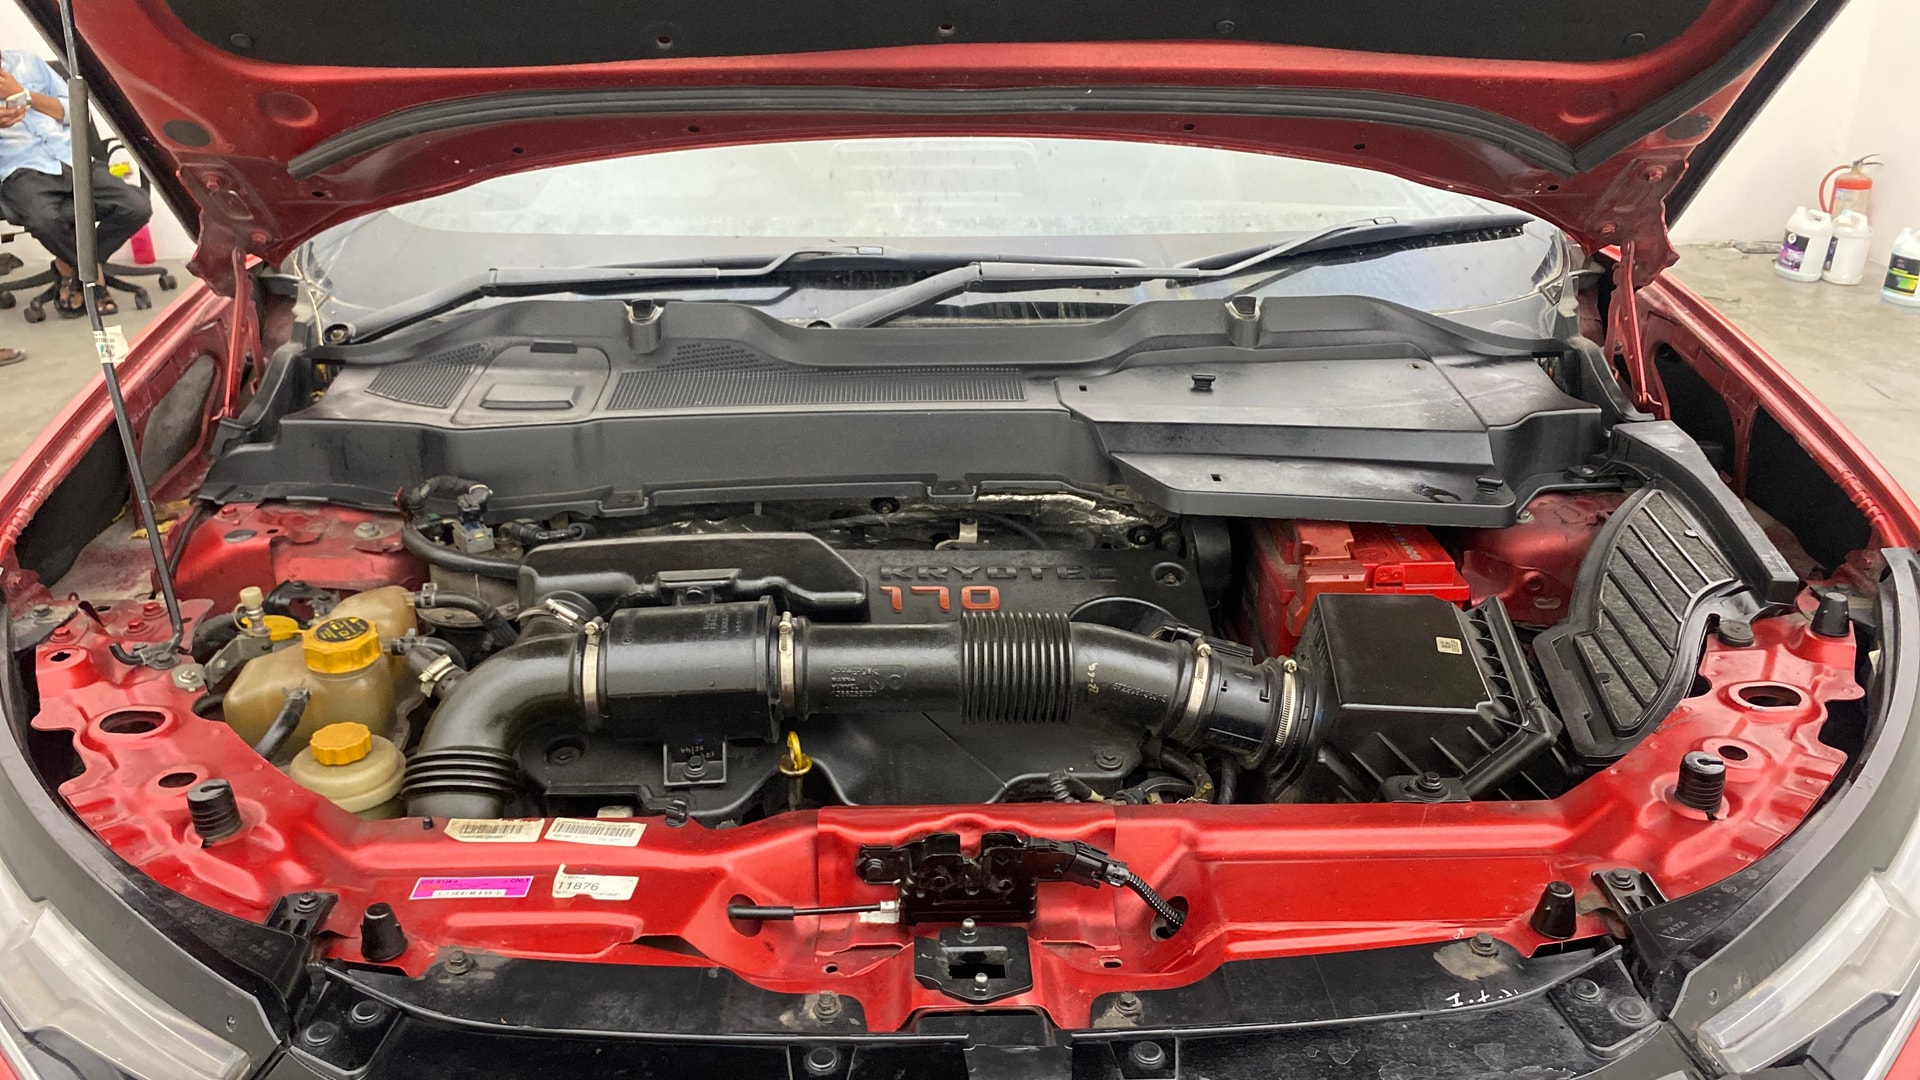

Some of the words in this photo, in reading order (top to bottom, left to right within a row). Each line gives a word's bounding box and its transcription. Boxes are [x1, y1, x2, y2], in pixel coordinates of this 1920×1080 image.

[879, 564, 1117, 583] KRYOTEC
[879, 584, 1000, 612] 170
[558, 881, 600, 891] 11876
[1661, 920, 1689, 935] TATA
